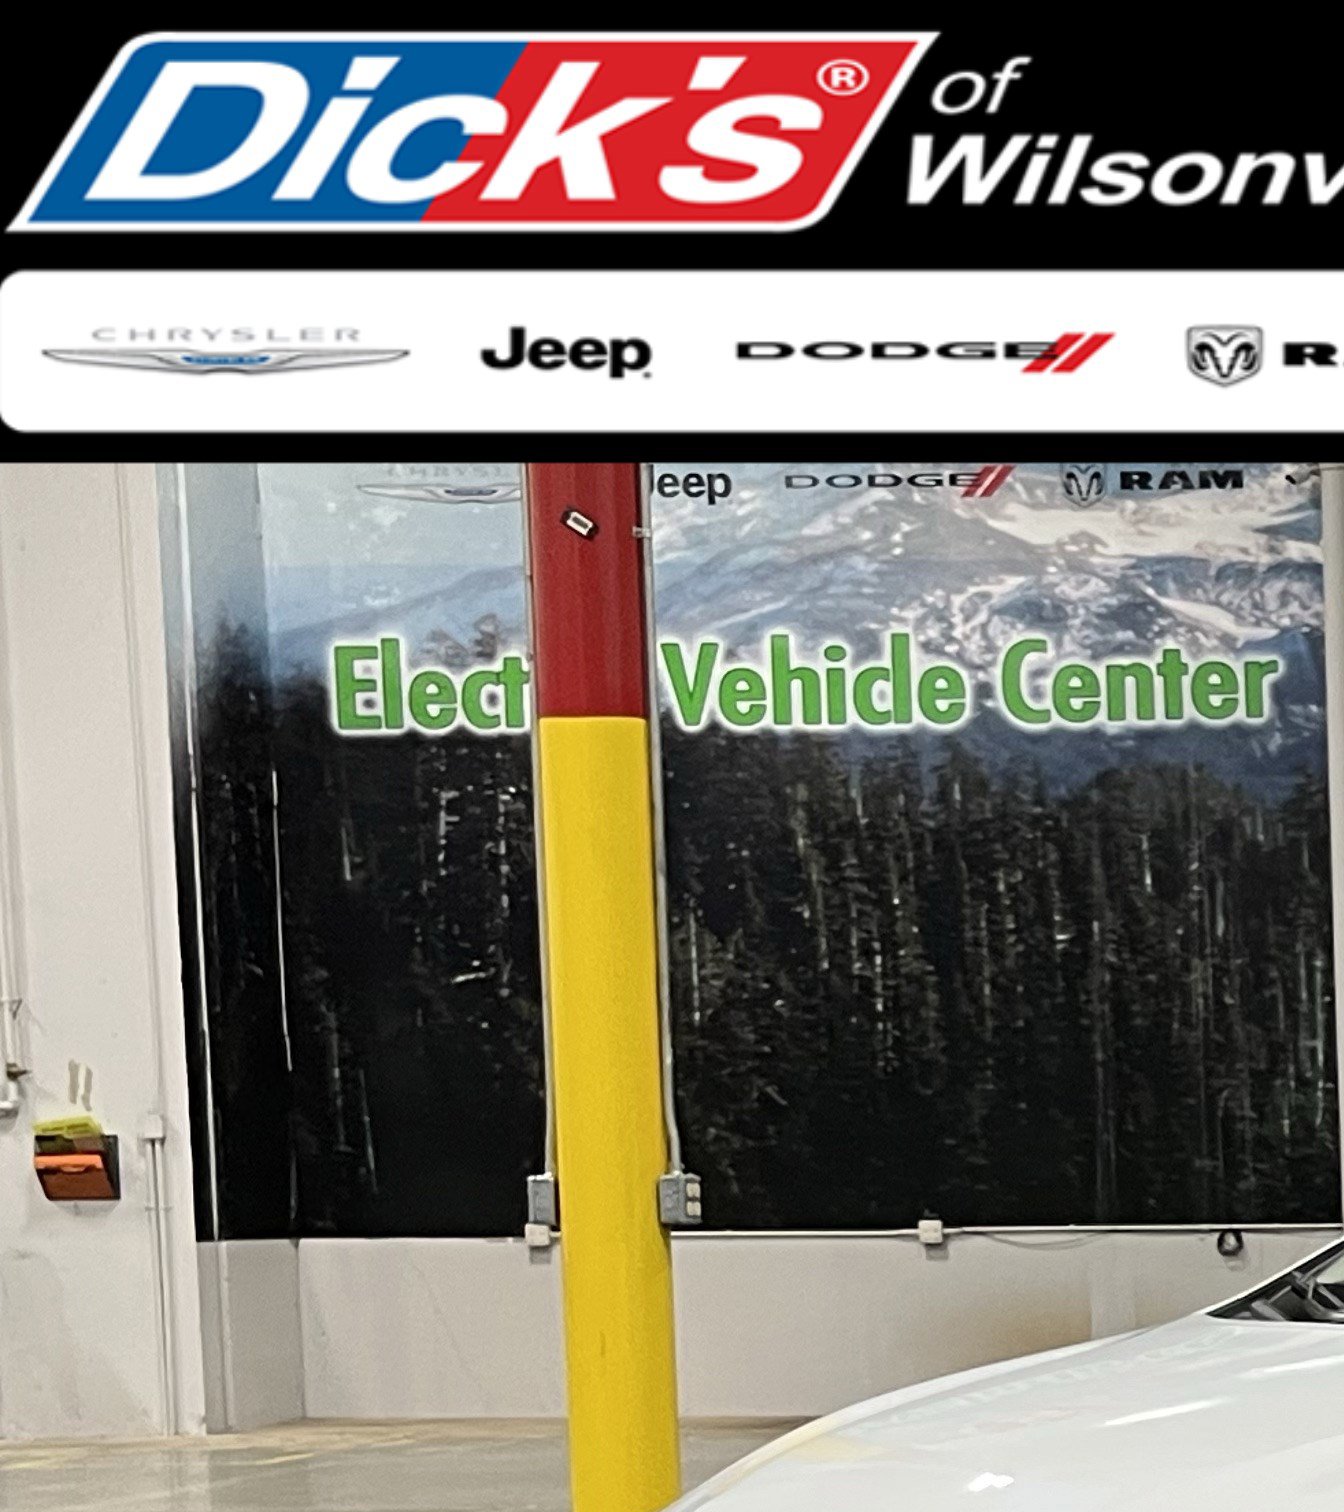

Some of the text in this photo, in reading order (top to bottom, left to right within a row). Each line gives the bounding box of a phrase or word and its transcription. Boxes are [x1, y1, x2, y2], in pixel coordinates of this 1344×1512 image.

[651, 471, 732, 504] eep
[784, 472, 979, 489] DODGE
[1120, 469, 1244, 490] RAM
[333, 634, 1279, 730] Elect Vehicle Center
